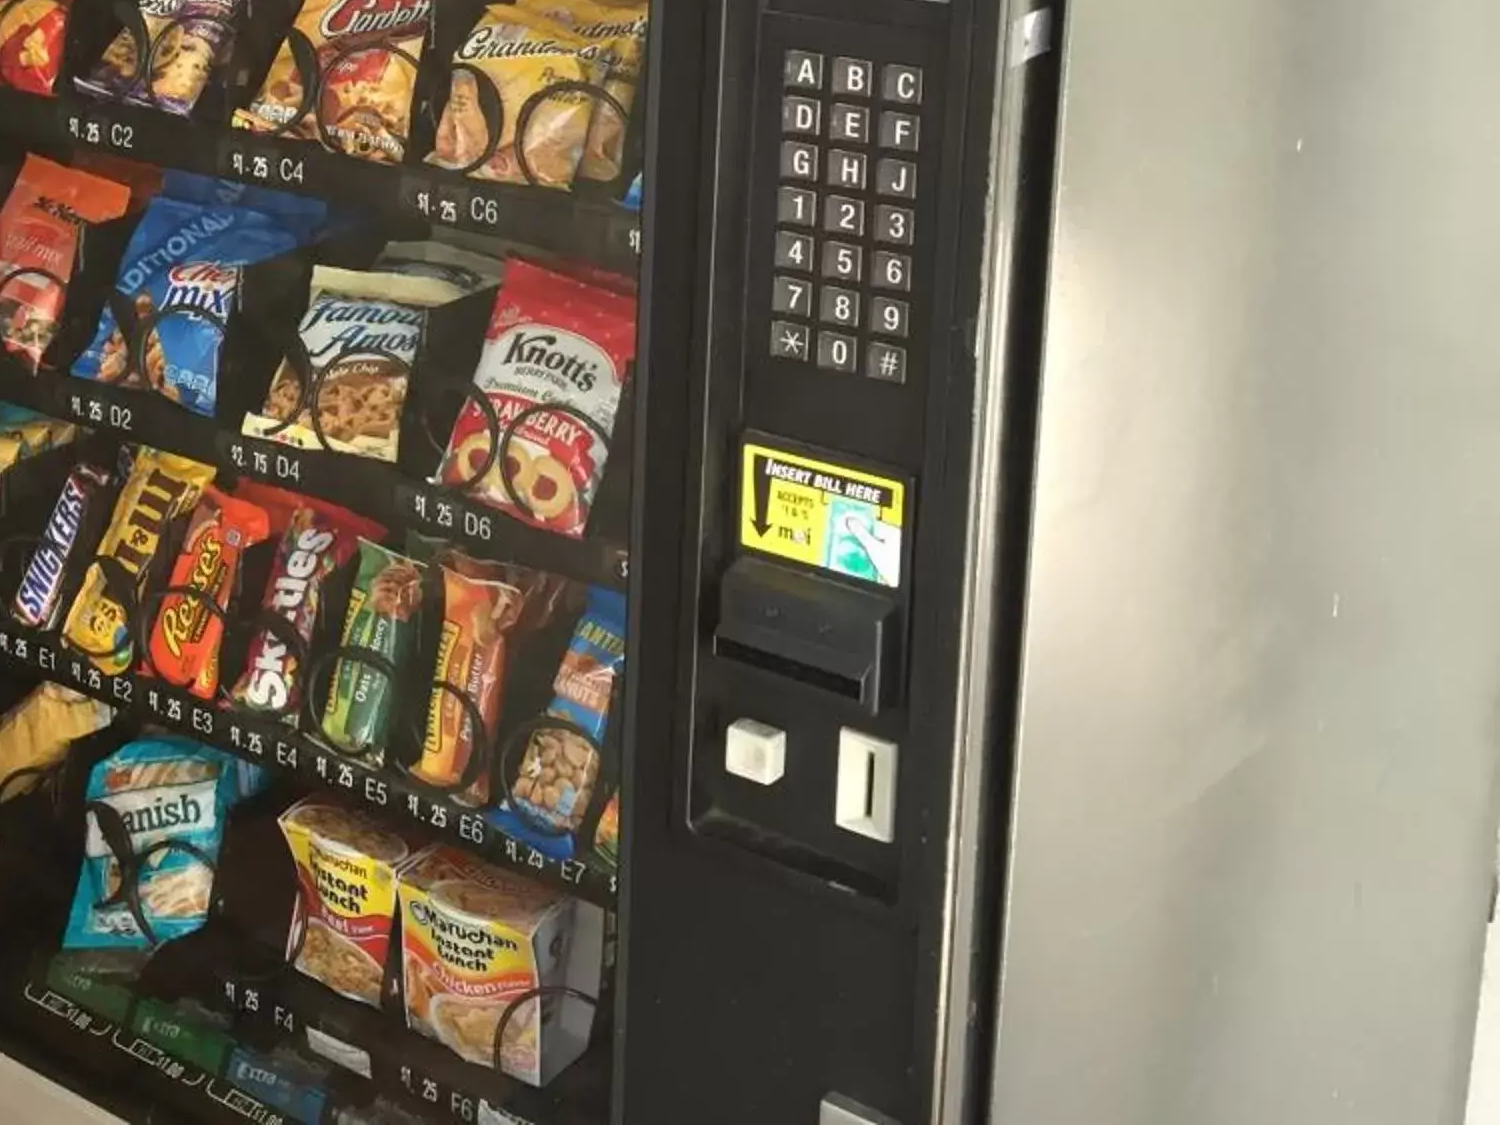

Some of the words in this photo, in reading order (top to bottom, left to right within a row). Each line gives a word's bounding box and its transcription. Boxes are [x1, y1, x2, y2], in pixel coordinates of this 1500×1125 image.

[797, 59, 815, 85] A
[847, 65, 864, 91] B
[897, 73, 915, 99] C
[110, 125, 134, 148] C2
[795, 105, 812, 129] D
[845, 112, 860, 138] E
[895, 120, 911, 146] F
[279, 157, 304, 183] C4
[793, 149, 810, 175] G
[841, 157, 858, 184] H
[891, 167, 907, 192] J
[470, 196, 499, 224] C6
[793, 195, 803, 220] 1
[840, 205, 856, 229] 2
[889, 213, 905, 238] 3
[788, 241, 803, 265] 4
[837, 249, 852, 274] 5
[886, 259, 902, 285] 6
[787, 285, 803, 309] 7
[835, 295, 850, 321] 8
[884, 305, 900, 331] 9
[308, 323, 417, 358] Amos
[832, 339, 848, 365] 0
[501, 331, 598, 393] Knott's
[110, 406, 133, 431] D2
[276, 454, 300, 482] D4
[764, 458, 813, 485] INSERT
[813, 474, 843, 494] BILL
[845, 481, 883, 505] HERE
[777, 489, 815, 510] ACCEPTS
[463, 513, 492, 540] D6
[16, 475, 89, 621] SNICKERS
[39, 648, 56, 671] E1
[113, 678, 133, 704] E2
[192, 709, 214, 734] E3
[276, 742, 297, 768] E4
[365, 778, 388, 805] E5
[121, 794, 201, 835] anish
[459, 818, 484, 844] E6
[560, 860, 586, 883] E7
[423, 904, 518, 952] Maruchan
[430, 927, 495, 961] Instant
[437, 944, 488, 972] Lunch
[432, 961, 497, 995] Chicken
[274, 1006, 294, 1032] F4
[451, 1091, 473, 1121] F6
